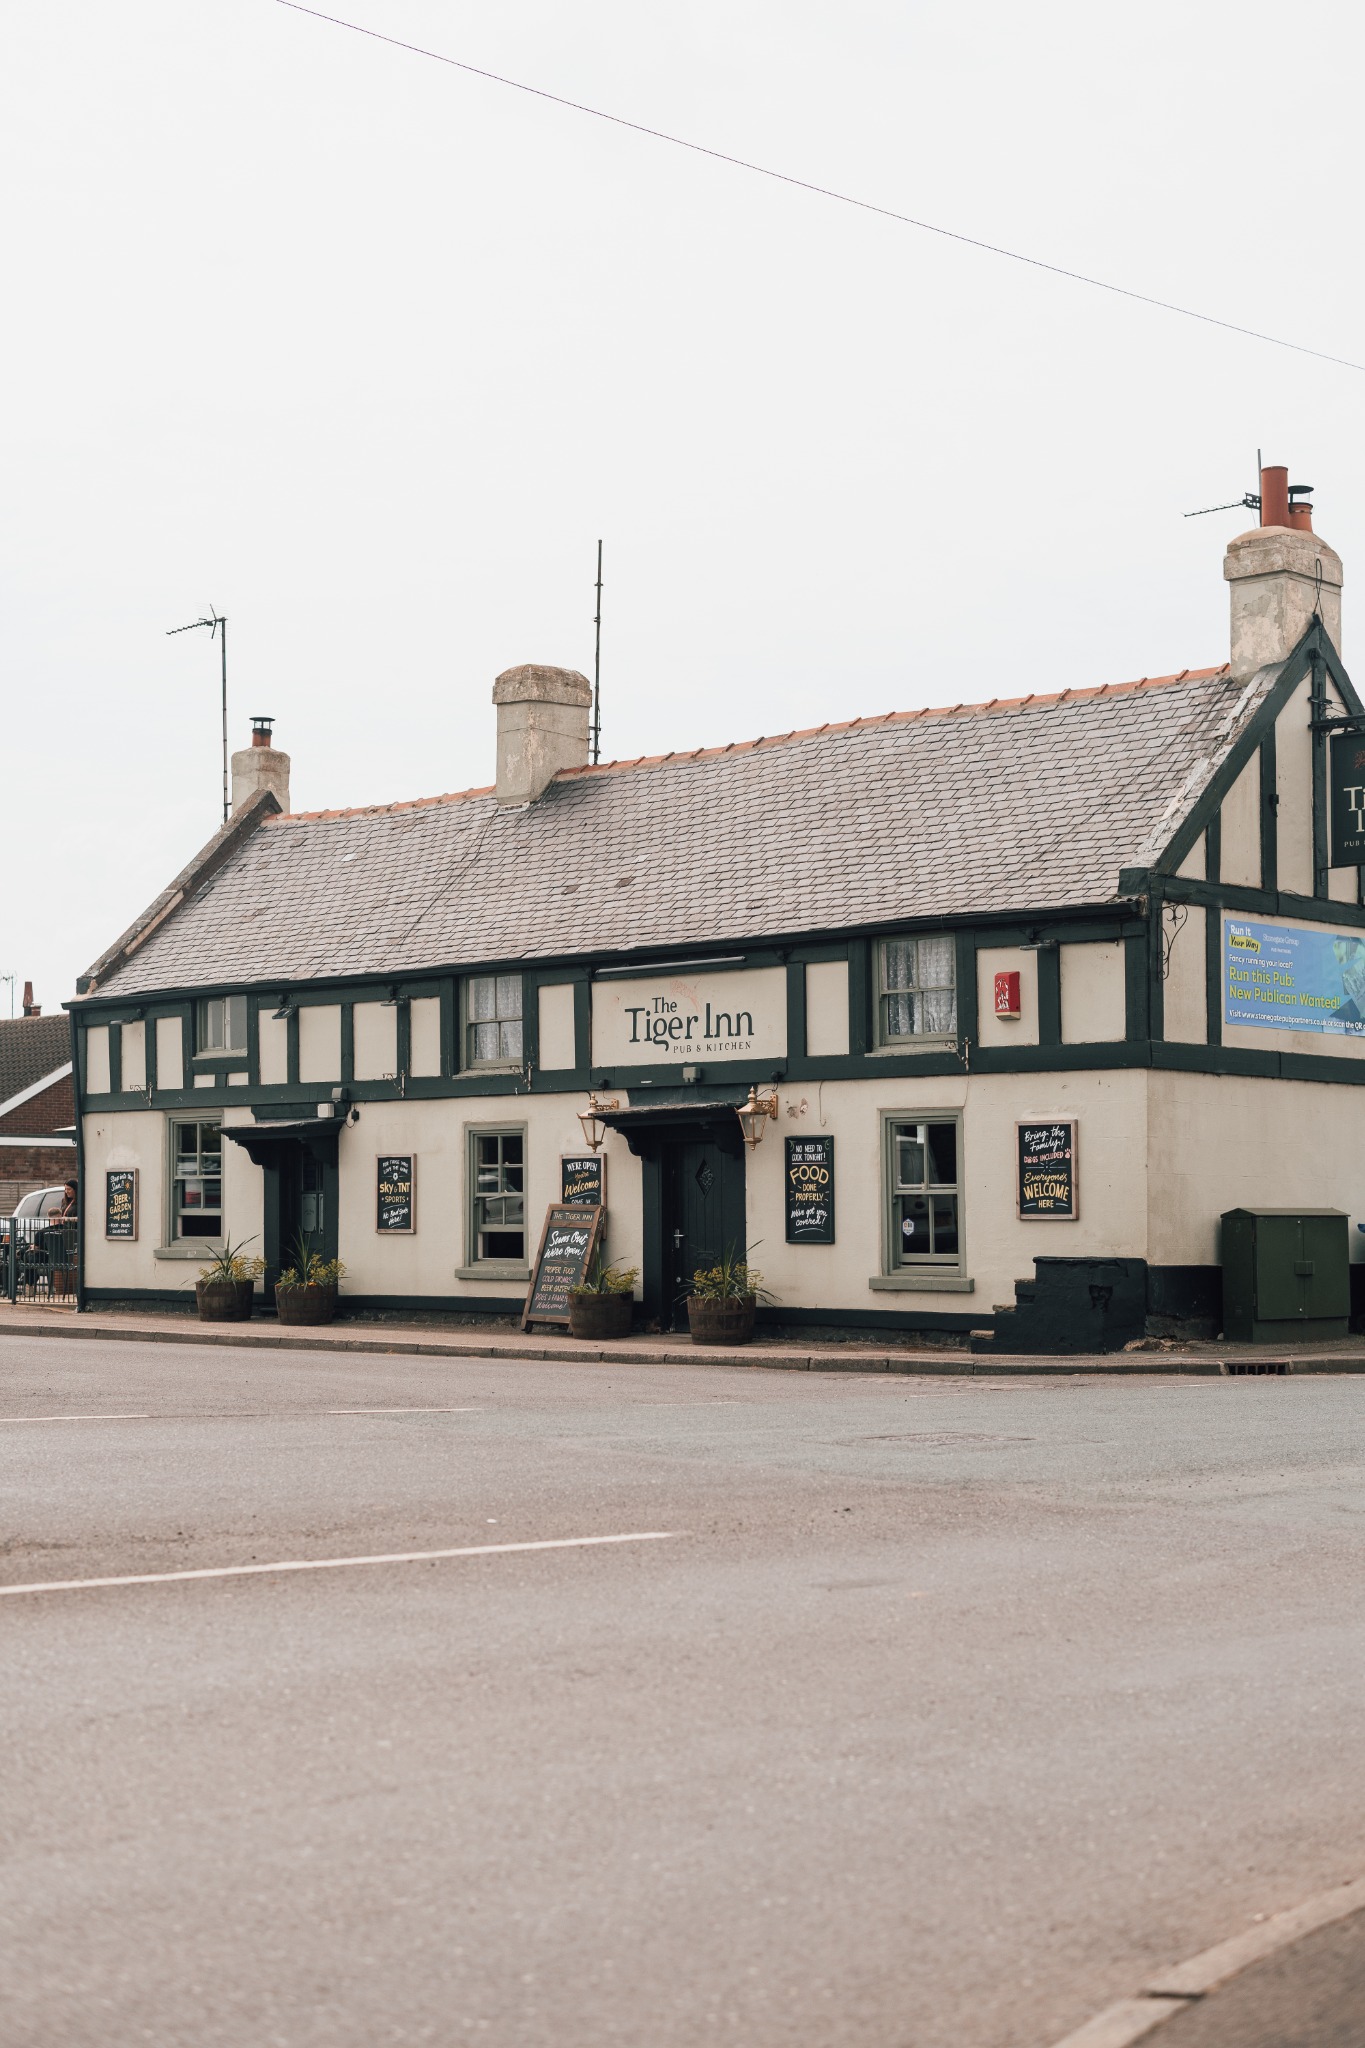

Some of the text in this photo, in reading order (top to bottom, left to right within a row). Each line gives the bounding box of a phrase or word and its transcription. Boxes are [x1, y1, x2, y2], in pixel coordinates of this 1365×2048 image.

[1230, 925, 1251, 936] Run It
[1230, 935, 1259, 952] Your Way
[1263, 934, 1299, 946] Stonegate Group
[1229, 954, 1244, 965] Fancy
[1246, 958, 1265, 967] running
[1278, 960, 1293, 968] local?
[1229, 966, 1295, 987] Run this Pub:
[1229, 985, 1340, 1009] New Publican Wanted!
[652, 997, 677, 1013] The
[1242, 1011, 1327, 1026] www.stonegatepubpartners.co.uk
[1355, 1022, 1362, 1030] QR
[625, 1003, 754, 1052] Tiger Inn
[673, 1045, 692, 1053] PUB
[706, 1041, 751, 1052] KITCHEN
[1024, 1126, 1065, 1142] Bring the
[1030, 1137, 1064, 1152] Family!
[804, 1152, 826, 1161] TONIGHT!
[1040, 1152, 1063, 1161] INCLUDED
[583, 1162, 597, 1172] OPEN
[790, 1165, 829, 1185] FOOD
[1024, 1172, 1067, 1184] Everyone's
[398, 1183, 410, 1192] TNT
[565, 1180, 599, 1197] Welcome
[1023, 1182, 1069, 1201] WELCOME
[114, 1194, 128, 1205] BEER
[796, 1193, 824, 1201] PROPERLY
[110, 1203, 131, 1214] GARDEN
[1039, 1200, 1054, 1208] HERE
[806, 1207, 815, 1218] got
[816, 1209, 828, 1219] you
[796, 1217, 826, 1227] covered!
[571, 1231, 588, 1246] Out
